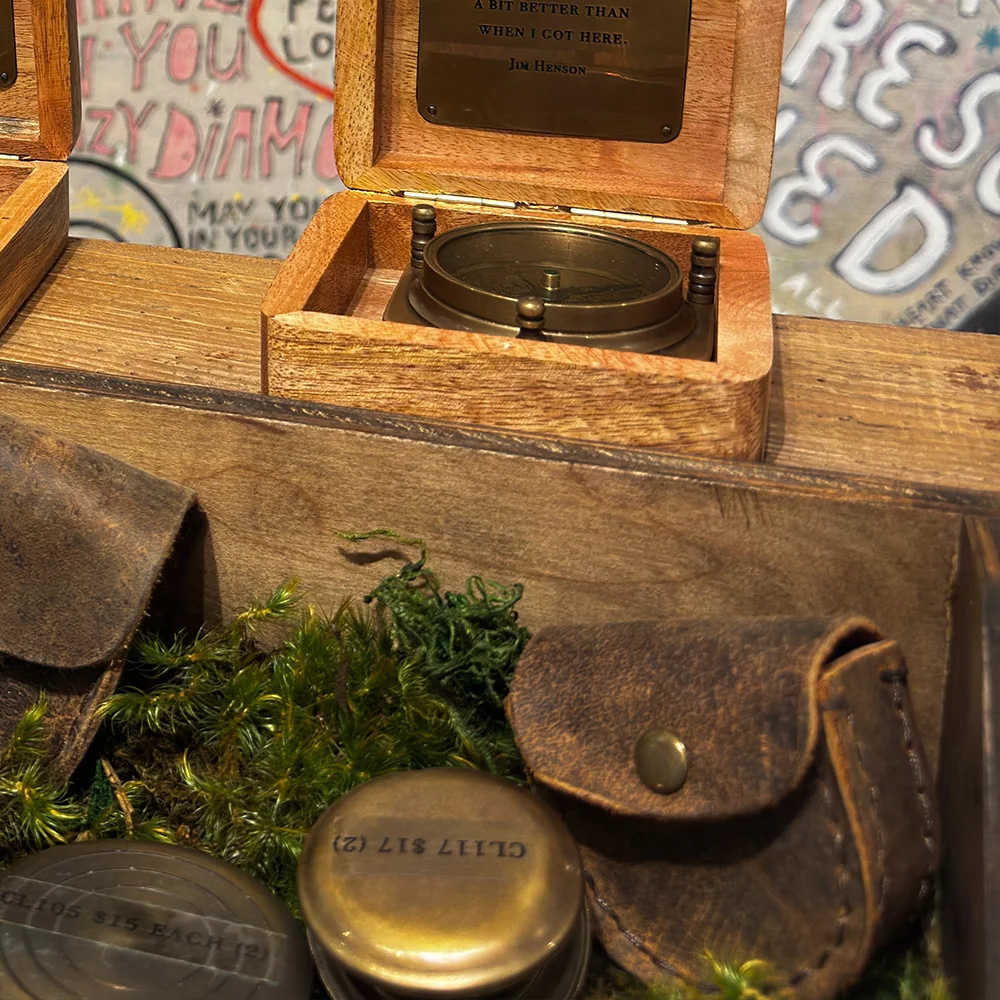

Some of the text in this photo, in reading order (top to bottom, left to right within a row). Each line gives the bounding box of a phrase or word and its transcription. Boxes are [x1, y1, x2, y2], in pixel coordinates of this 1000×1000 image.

[474, 0, 629, 18] A BIT BETTER THAN
[477, 25, 628, 44] WHEN I GOT HERE.
[333, 834, 528, 859] CL117 $17 (2)
[0, 887, 269, 963] CL105 $15 EACH (2)
